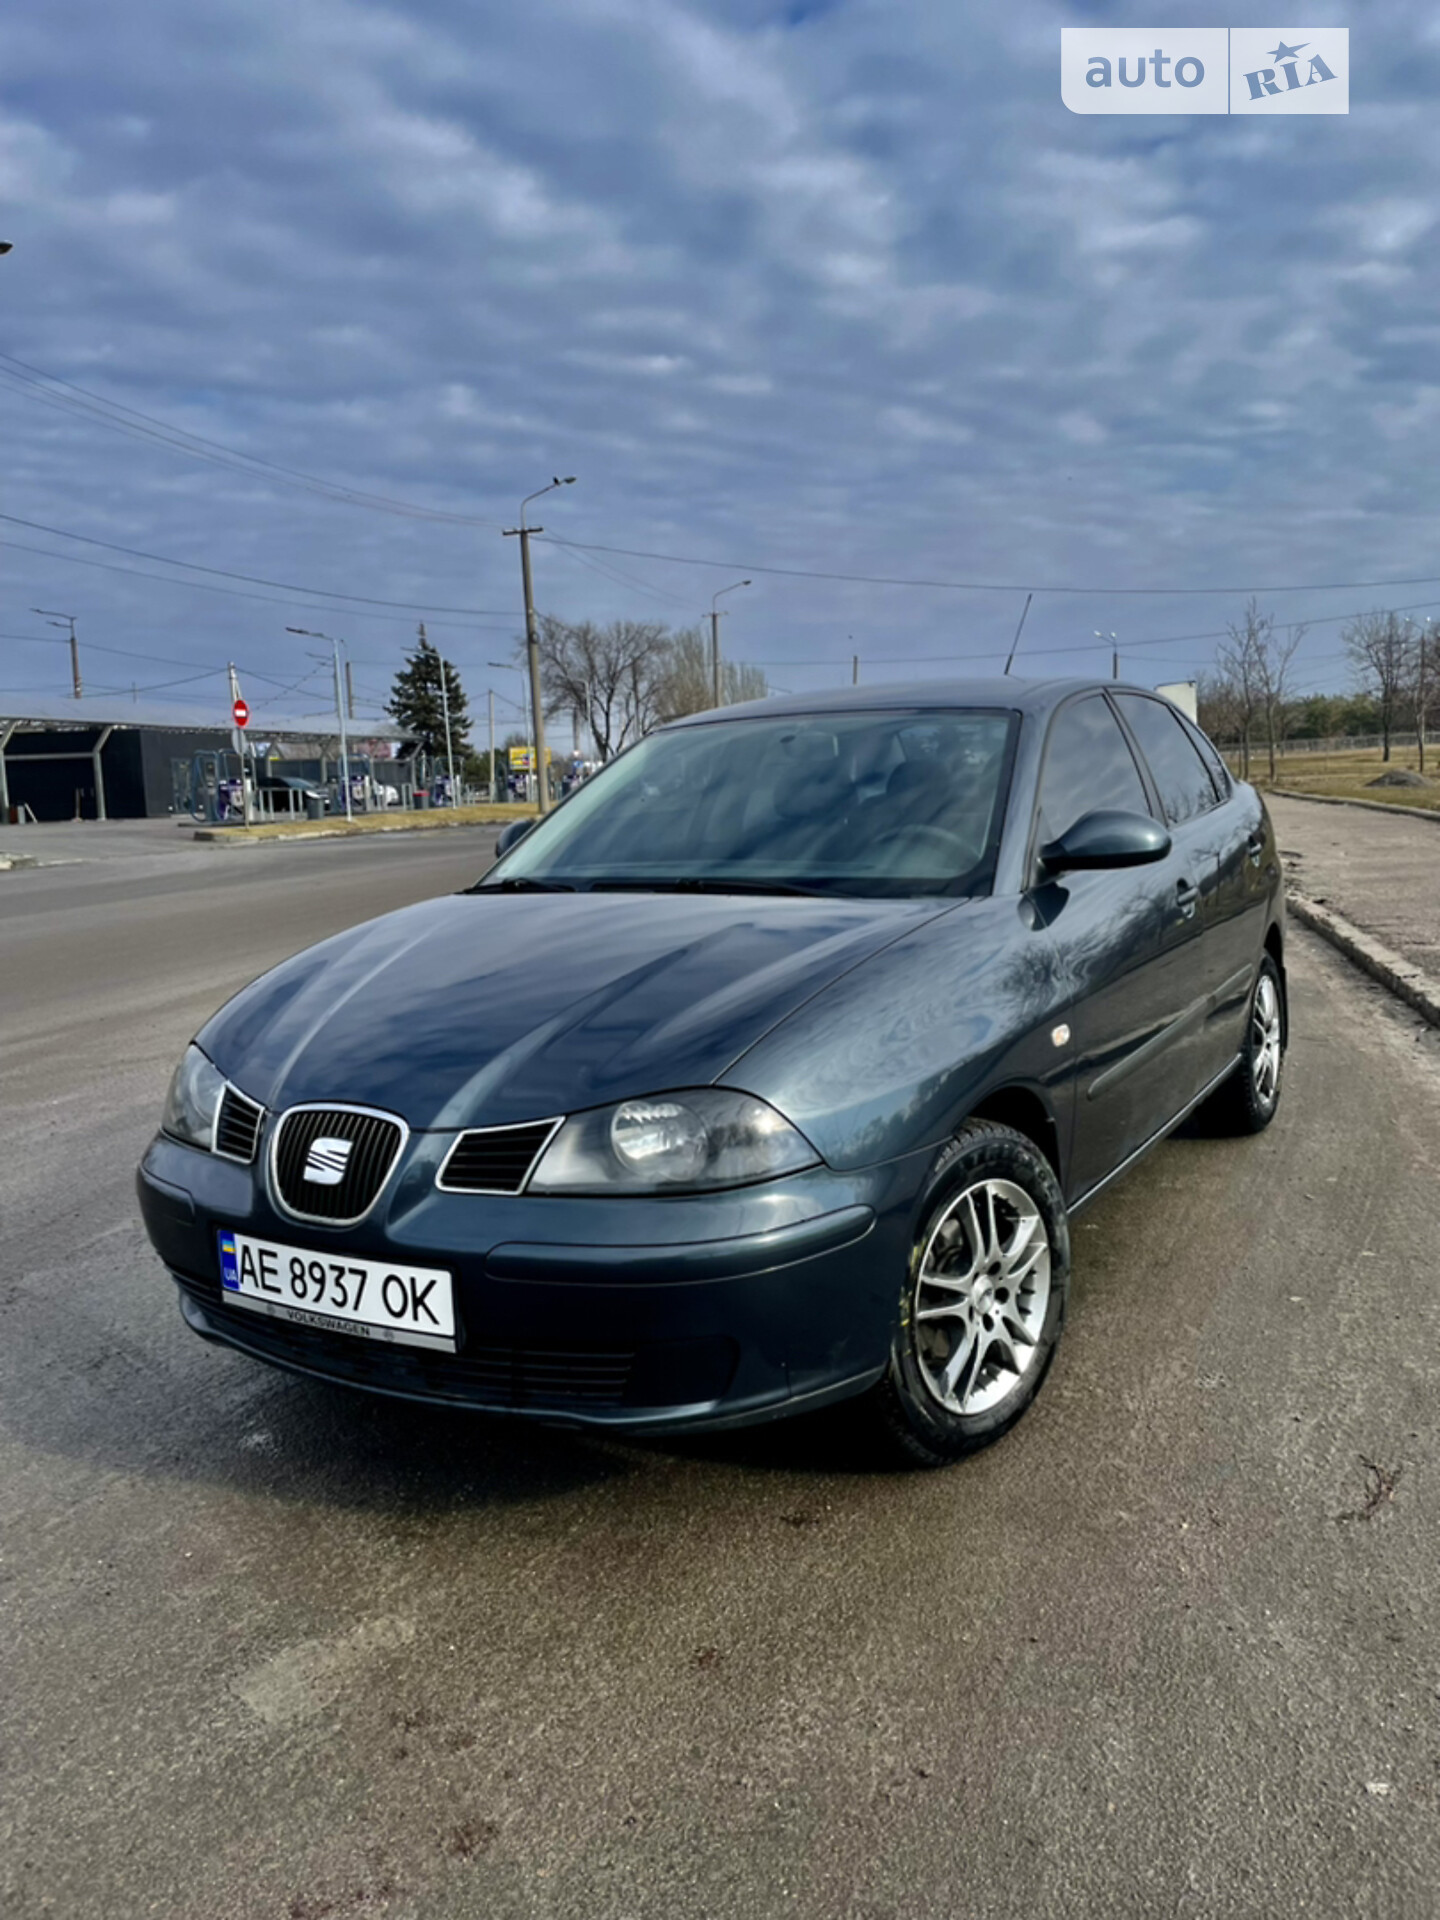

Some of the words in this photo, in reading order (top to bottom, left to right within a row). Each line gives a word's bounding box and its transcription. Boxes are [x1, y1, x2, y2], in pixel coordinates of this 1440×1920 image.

[240, 1244, 282, 1294] AE
[289, 1256, 367, 1311] 8937
[382, 1274, 440, 1325] OK
[286, 1309, 371, 1337] VOLKSWAGEN
